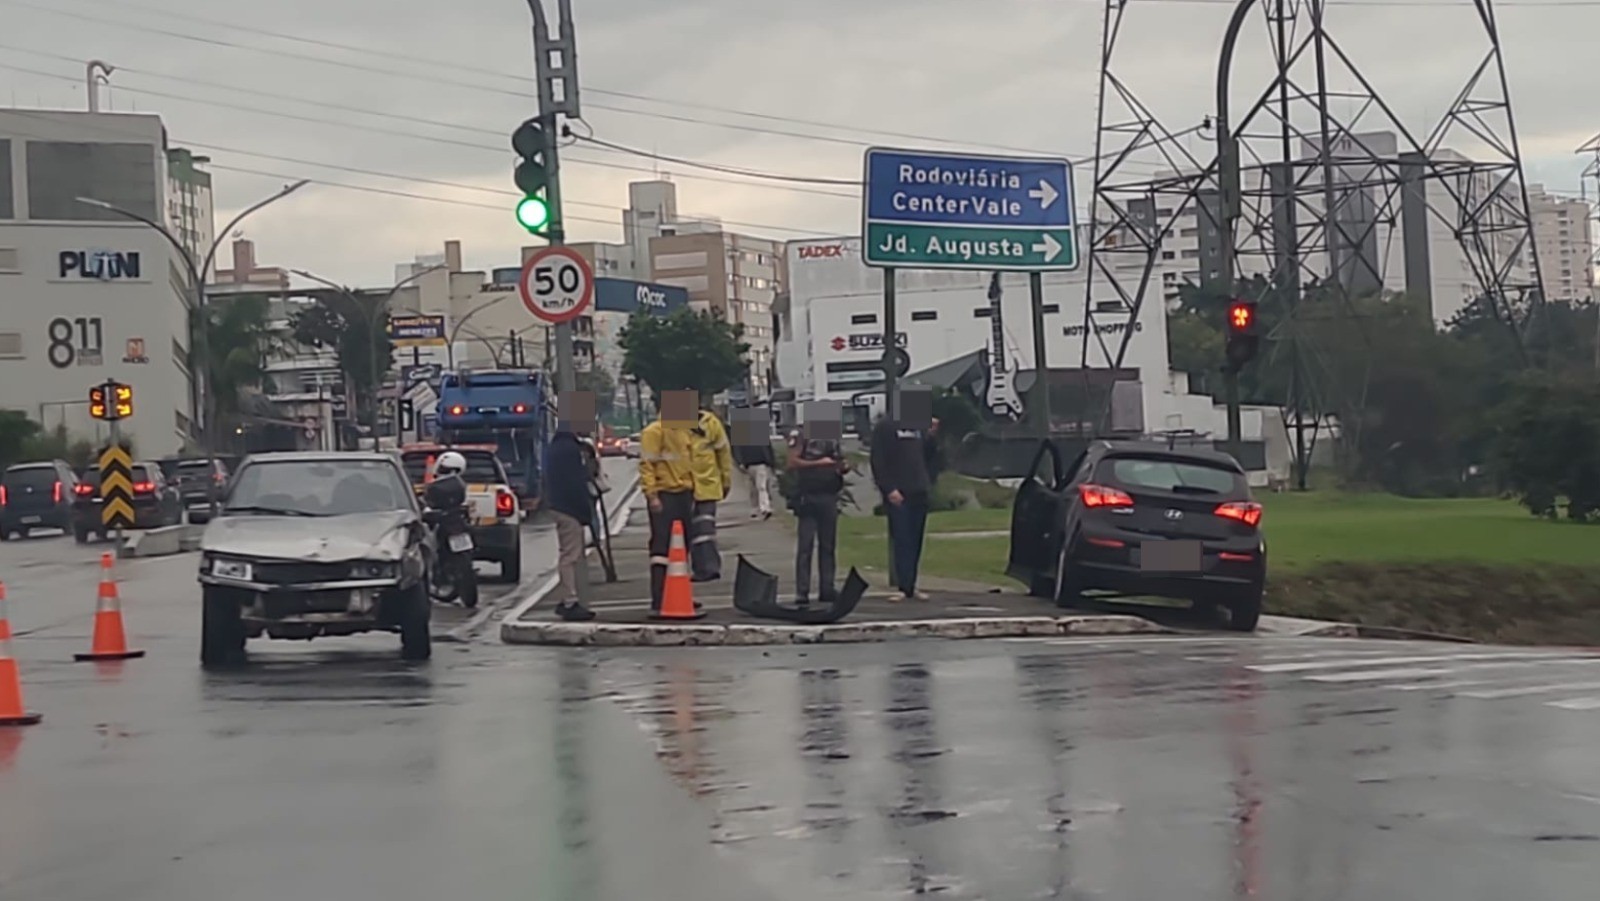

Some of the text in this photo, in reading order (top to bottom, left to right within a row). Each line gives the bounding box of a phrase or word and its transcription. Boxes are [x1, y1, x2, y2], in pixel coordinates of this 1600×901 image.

[900, 164, 1020, 189] Rodoviária
[879, 233, 1024, 260] Jd. Augusta
[535, 264, 578, 295] 50
[542, 298, 575, 308] km/h
[48, 317, 102, 369] 811
